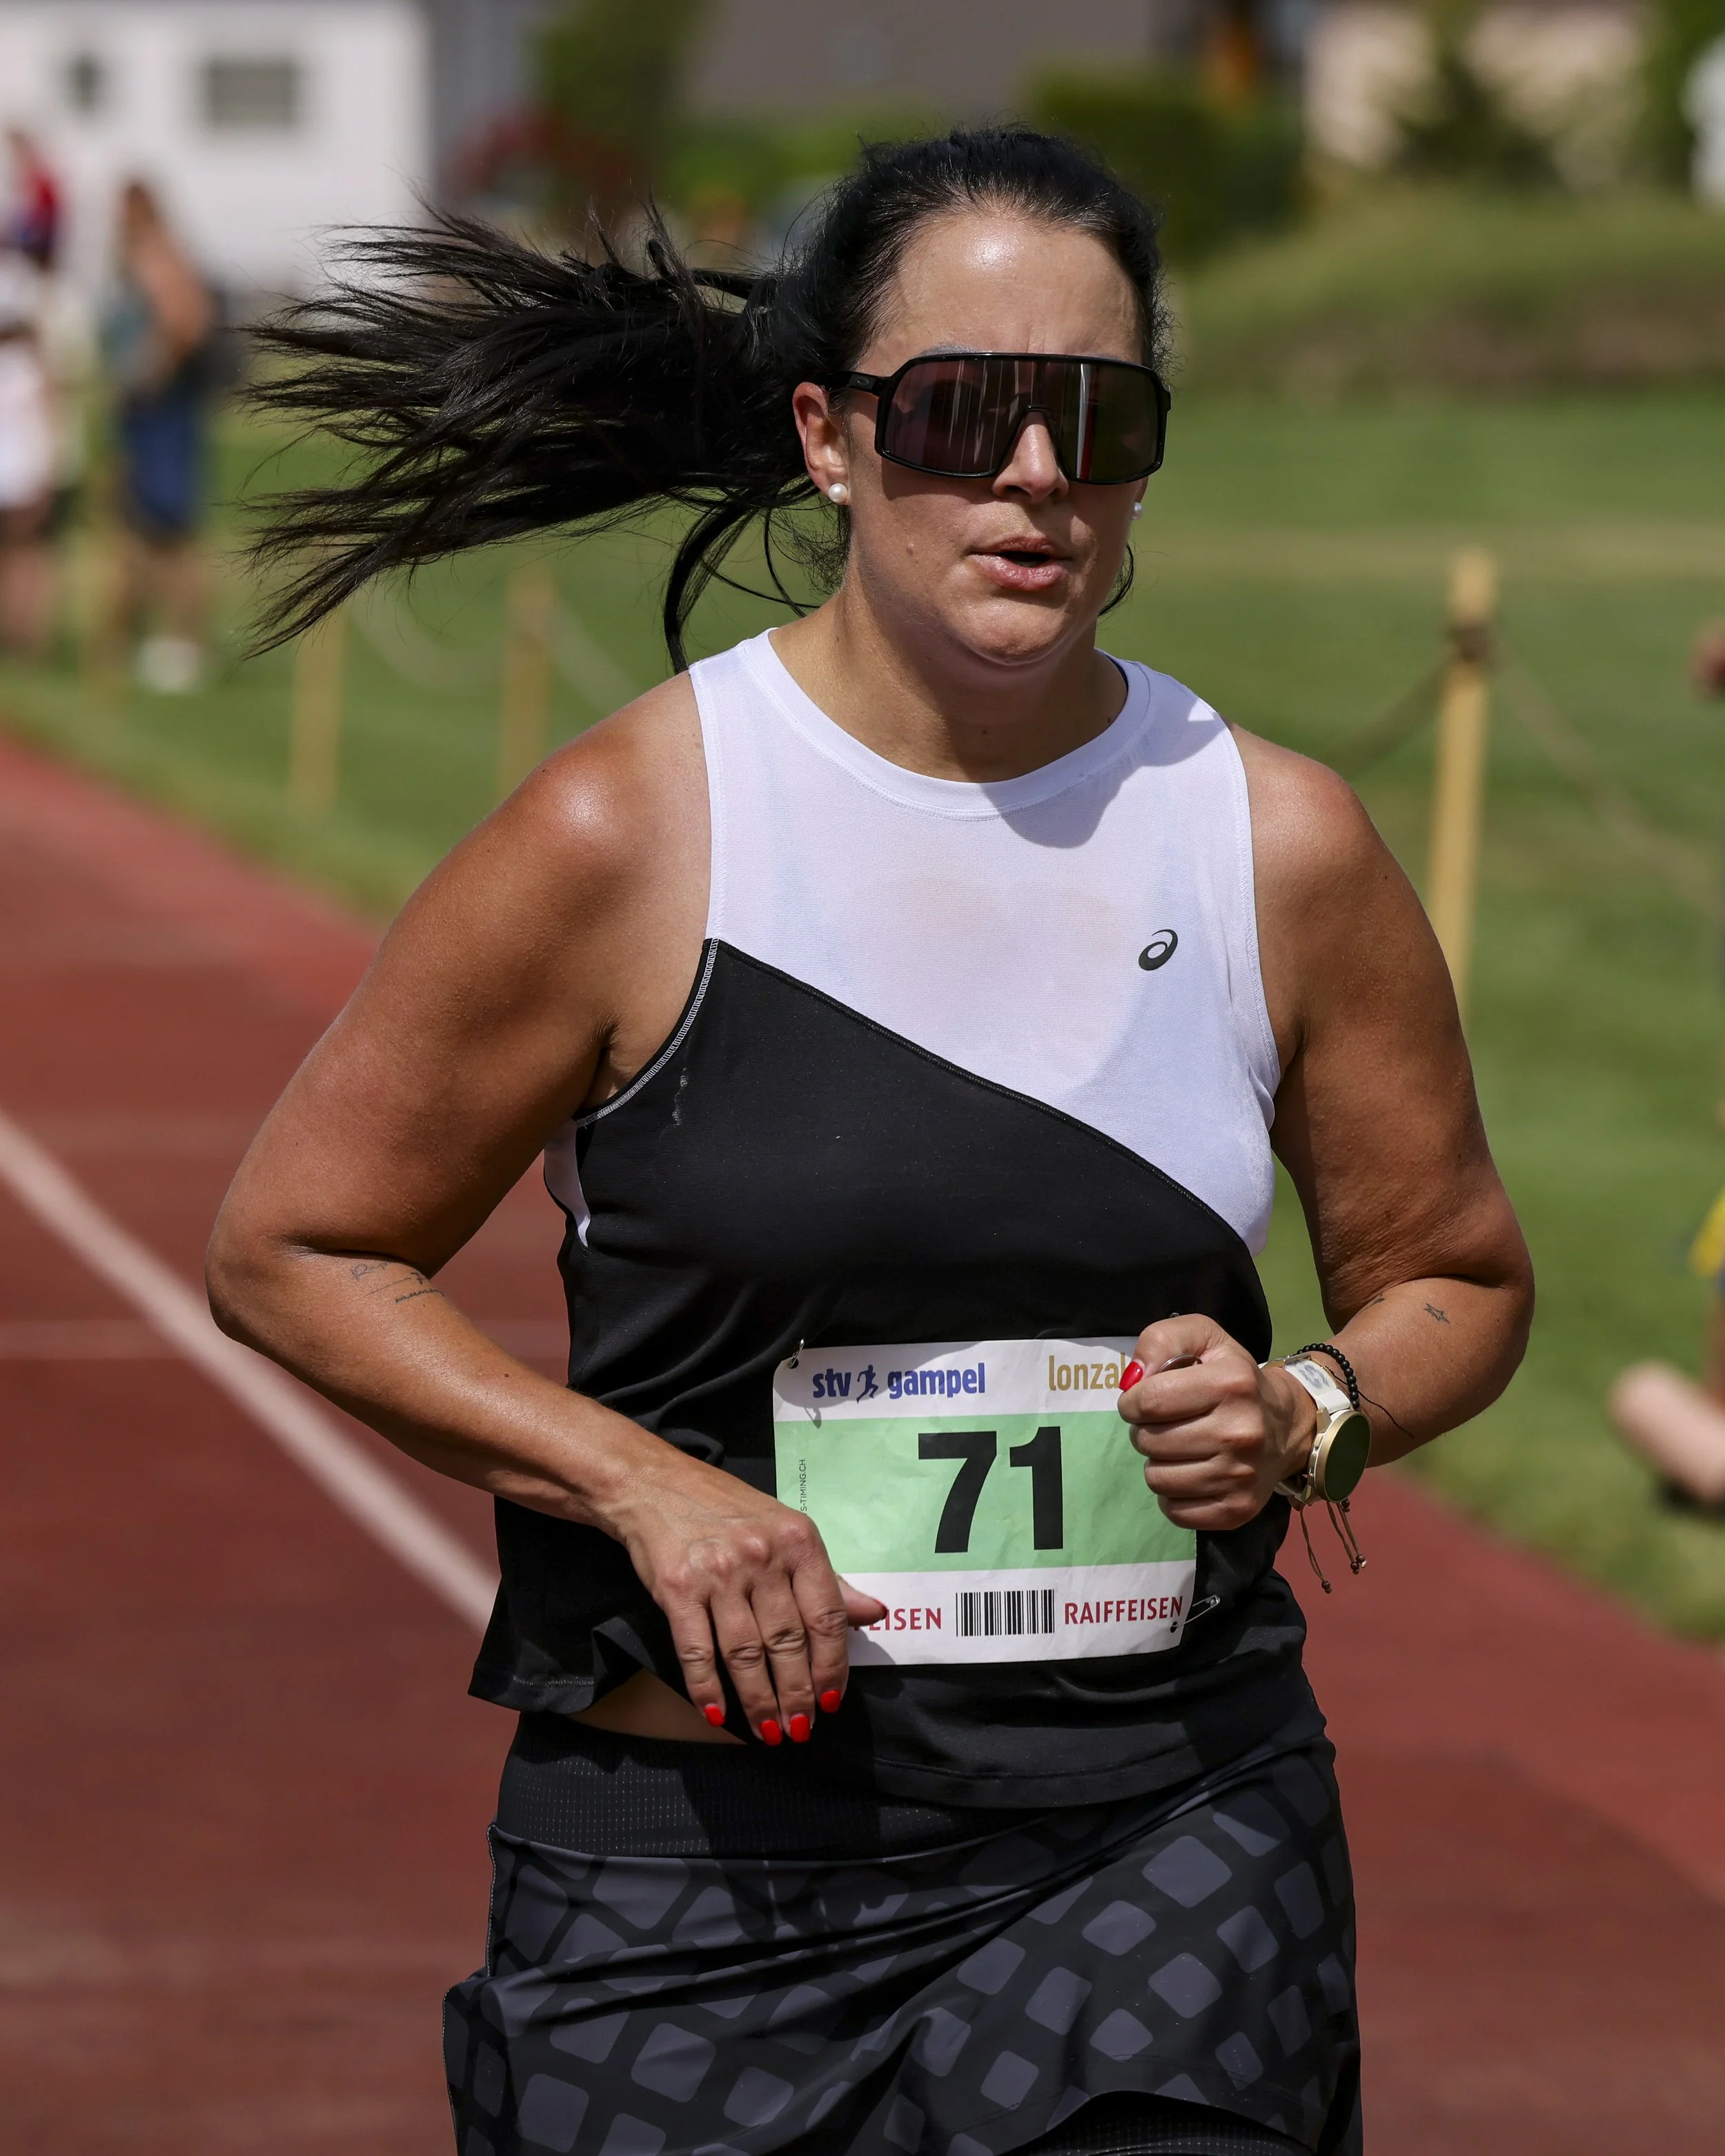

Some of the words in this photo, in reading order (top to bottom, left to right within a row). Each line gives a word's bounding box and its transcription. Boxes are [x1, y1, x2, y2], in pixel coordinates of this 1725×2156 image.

[813, 1368, 851, 1398] stv
[887, 1362, 985, 1399] gampel
[918, 1426, 1064, 1554] 71
[1065, 1596, 1183, 1625] RAIFFEISEN
